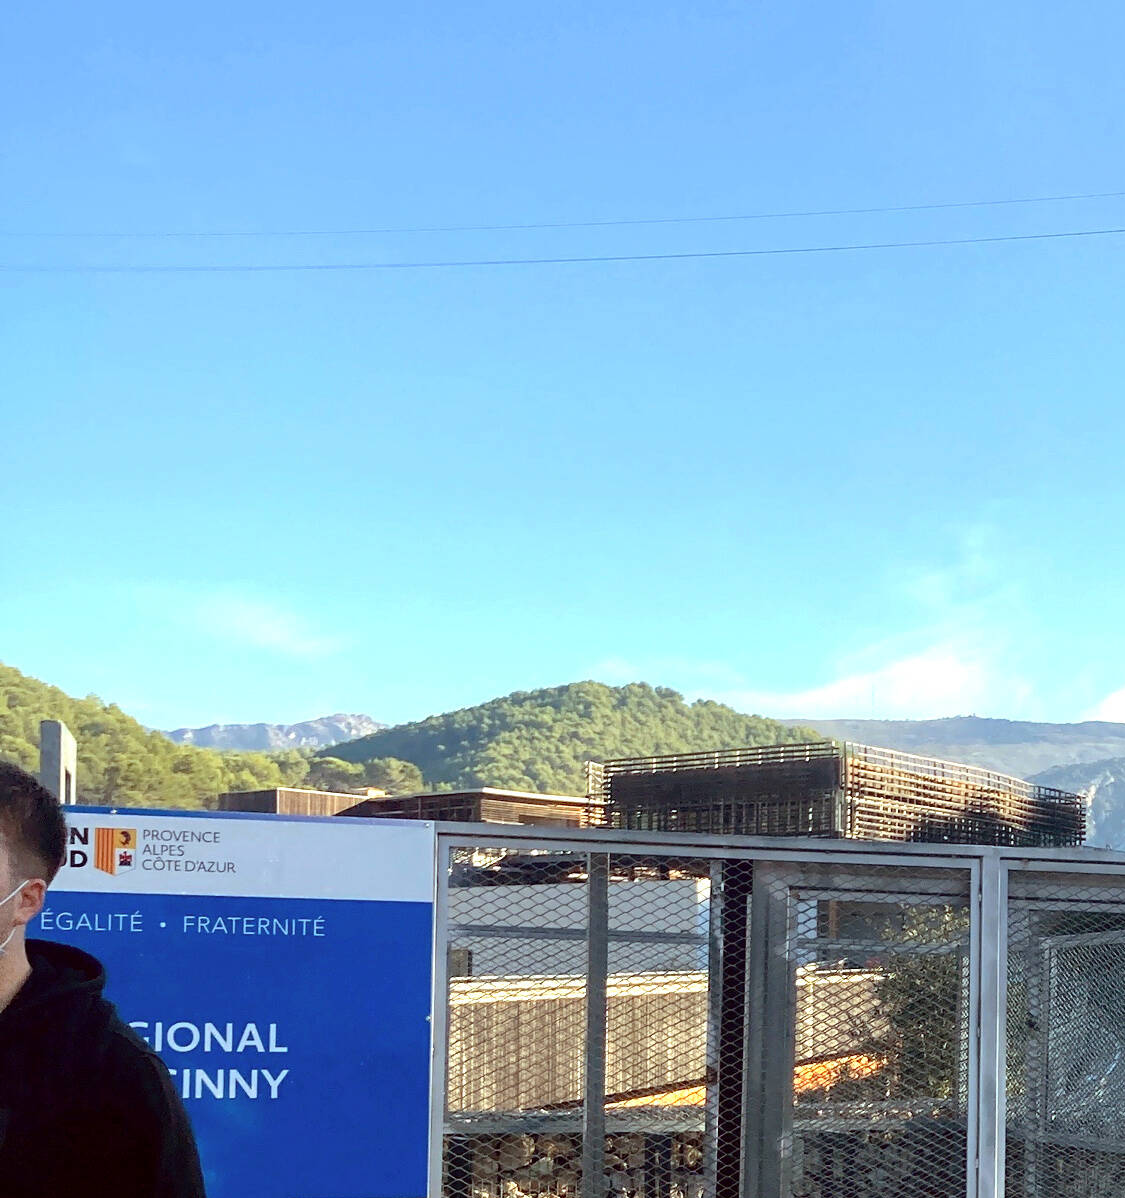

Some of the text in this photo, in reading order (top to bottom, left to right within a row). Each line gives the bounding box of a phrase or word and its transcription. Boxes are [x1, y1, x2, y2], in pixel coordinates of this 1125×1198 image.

[142, 829, 221, 843] PROVENCE
[142, 844, 185, 857] ALPES
[142, 857, 237, 873] CÔTE D'AZUR
[40, 907, 326, 937] ÉGALITÉ FRATERNITÉ
[169, 1068, 290, 1099] INNY
